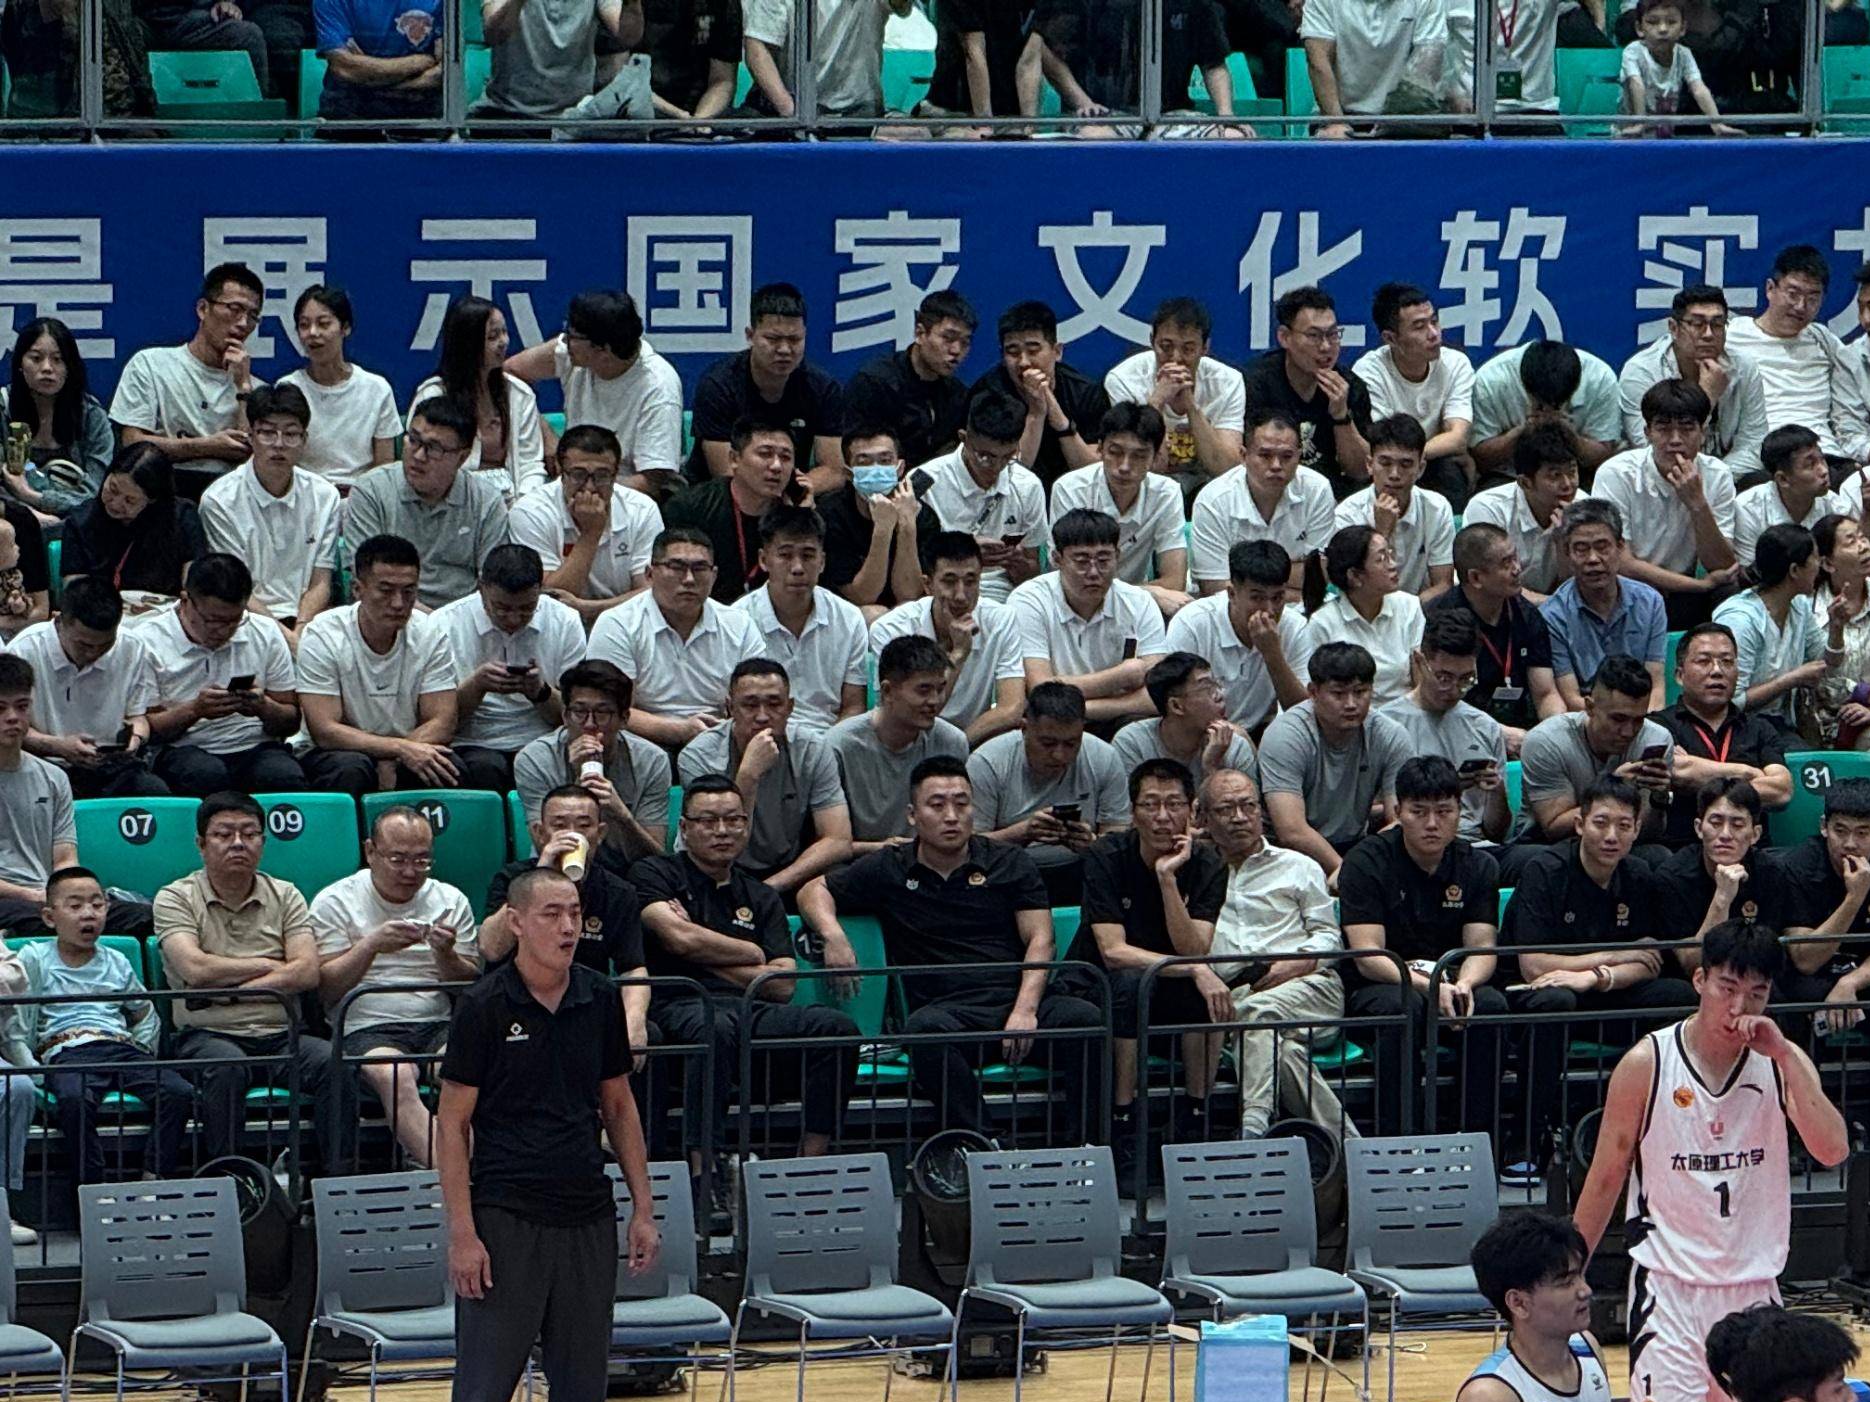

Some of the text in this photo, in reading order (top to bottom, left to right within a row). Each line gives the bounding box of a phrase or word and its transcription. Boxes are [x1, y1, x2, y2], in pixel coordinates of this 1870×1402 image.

[1804, 767, 1831, 788] 31
[121, 815, 152, 837] 07
[269, 811, 302, 834] 09
[1670, 1147, 1765, 1173] 太原理工大学
[1713, 1180, 1731, 1219] 1
[1641, 1373, 1652, 1397] 1
